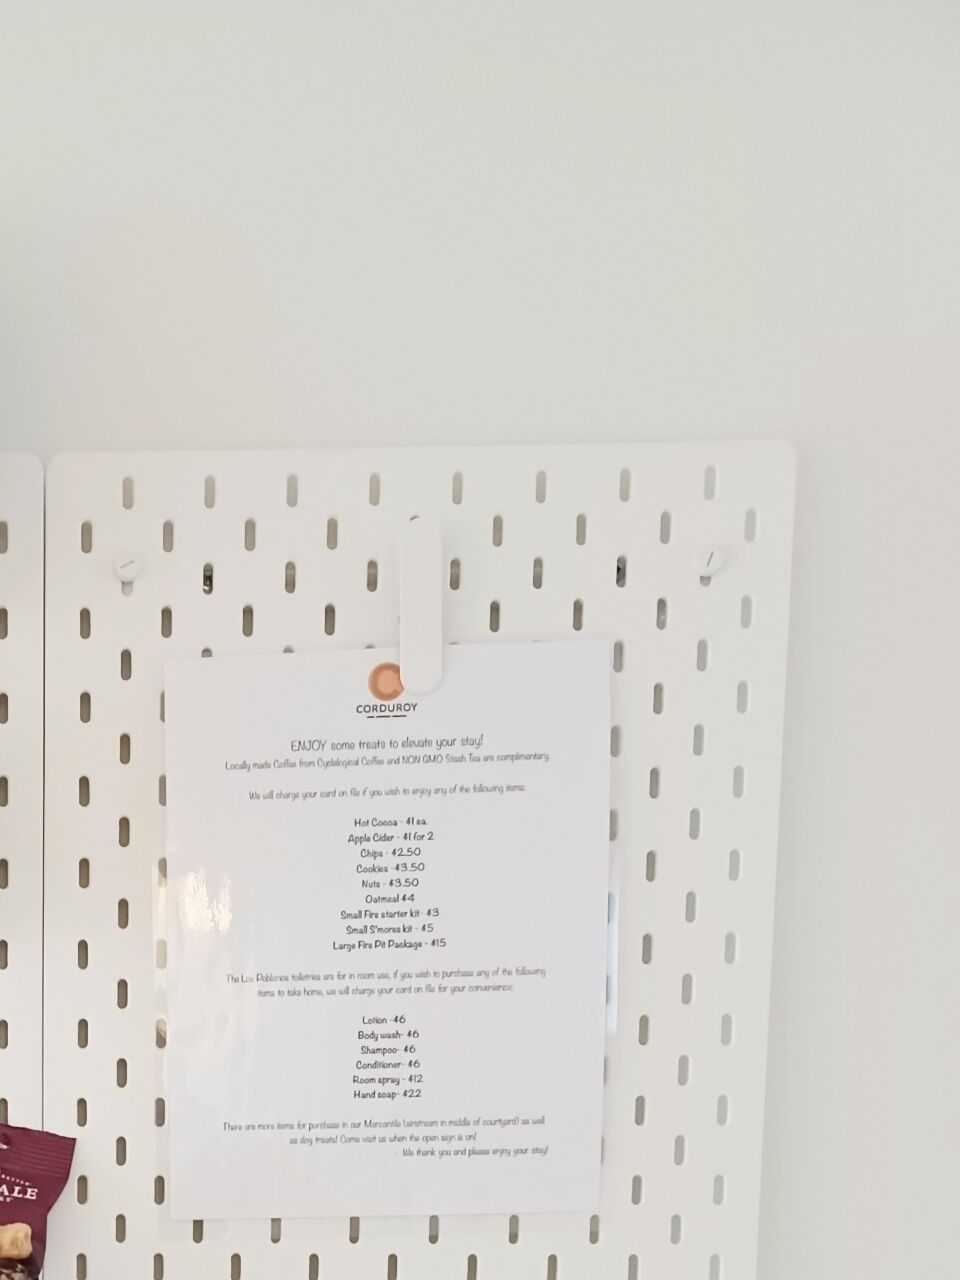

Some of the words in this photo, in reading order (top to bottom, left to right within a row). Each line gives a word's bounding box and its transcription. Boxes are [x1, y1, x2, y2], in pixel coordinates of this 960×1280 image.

[356, 703, 417, 713] CORDUROY
[291, 739, 327, 752] ENJOY
[359, 739, 385, 749] treats
[390, 739, 398, 748] to
[401, 736, 432, 747] elevate
[436, 738, 457, 749] your
[461, 734, 483, 749] stay!
[225, 760, 250, 772] Locally
[252, 760, 271, 769] made
[273, 759, 296, 768] Coffee
[299, 758, 315, 767] from
[361, 756, 384, 765] Coffee
[387, 756, 400, 765] and
[402, 755, 421, 764] NON
[423, 754, 443, 763] GMO
[469, 753, 481, 762] Tea
[249, 791, 260, 800] We
[263, 790, 274, 799] will
[276, 790, 299, 801] charge
[302, 792, 317, 800] your
[320, 788, 336, 798] card
[350, 787, 360, 797] file
[362, 787, 368, 796] if
[369, 790, 382, 799] you
[384, 786, 400, 795] wish
[412, 788, 431, 797] enjoy
[433, 788, 447, 796] any
[449, 784, 457, 793] of
[459, 785, 470, 793] the
[473, 784, 503, 794] following
[354, 818, 369, 827] Hot
[371, 818, 397, 827] Cocoa
[406, 817, 414, 825] $1
[348, 833, 371, 845] Apple
[373, 833, 394, 842] Cider
[403, 832, 411, 840] $1
[413, 832, 425, 841] for
[427, 831, 434, 840] 2
[360, 849, 383, 860] Chips
[392, 847, 421, 856] $2.50
[356, 864, 388, 873] Cookies
[362, 880, 380, 888] Nuts
[389, 878, 419, 887] $3.50
[365, 894, 399, 903] Oatmeal
[402, 894, 414, 902] $4
[341, 910, 362, 919] Small
[364, 910, 378, 918] Fire
[381, 910, 408, 918] starter
[410, 909, 419, 917] kit
[427, 908, 439, 916] $3
[346, 925, 368, 935] Small
[370, 925, 401, 934] S'mores
[403, 924, 412, 933] kit
[421, 924, 433, 932] $5
[333, 941, 356, 952] Large
[358, 940, 372, 949] Fire
[375, 940, 386, 949] Pit
[388, 939, 422, 950] Package
[431, 938, 446, 947] $15
[363, 1016, 387, 1024] Lotion
[358, 1031, 378, 1042] Body
[407, 1030, 419, 1038] $6
[403, 1045, 416, 1053] $6
[408, 1060, 420, 1068] $6
[353, 1075, 376, 1084] Room
[378, 1077, 400, 1086] spray
[408, 1074, 423, 1083] $12
[354, 1090, 375, 1098] Hand
[403, 1089, 421, 1098] $22
